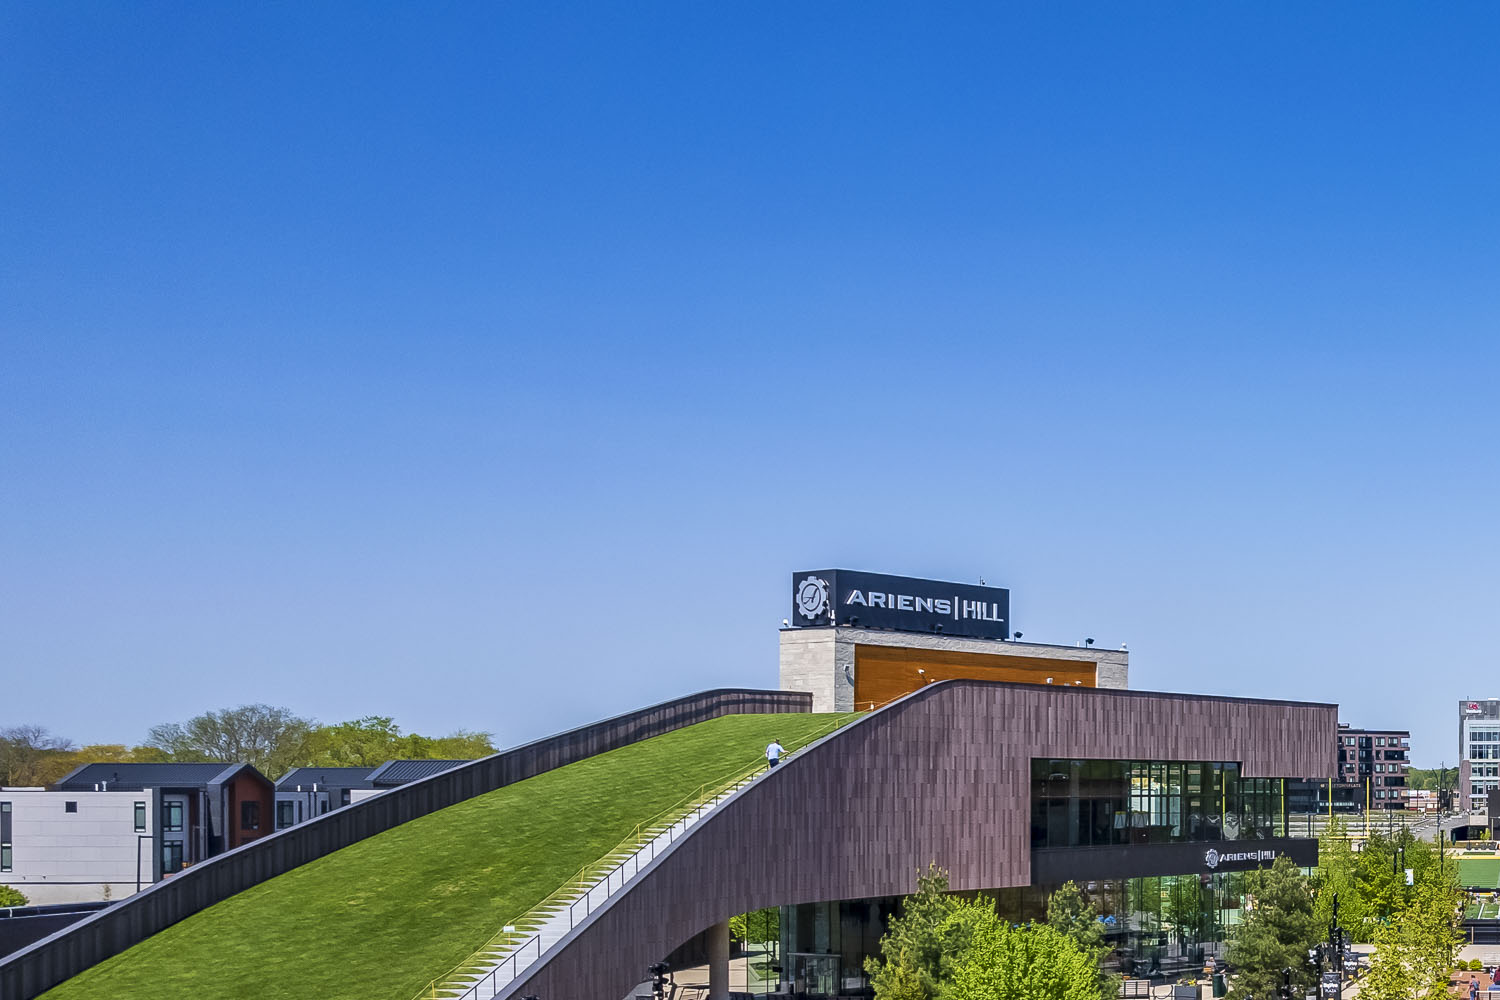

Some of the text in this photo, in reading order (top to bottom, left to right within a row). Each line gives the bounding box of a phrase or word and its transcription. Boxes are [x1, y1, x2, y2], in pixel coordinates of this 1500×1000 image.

[847, 589, 1004, 622] ARIENS HILL
[1220, 852, 1258, 862] ARIENS
